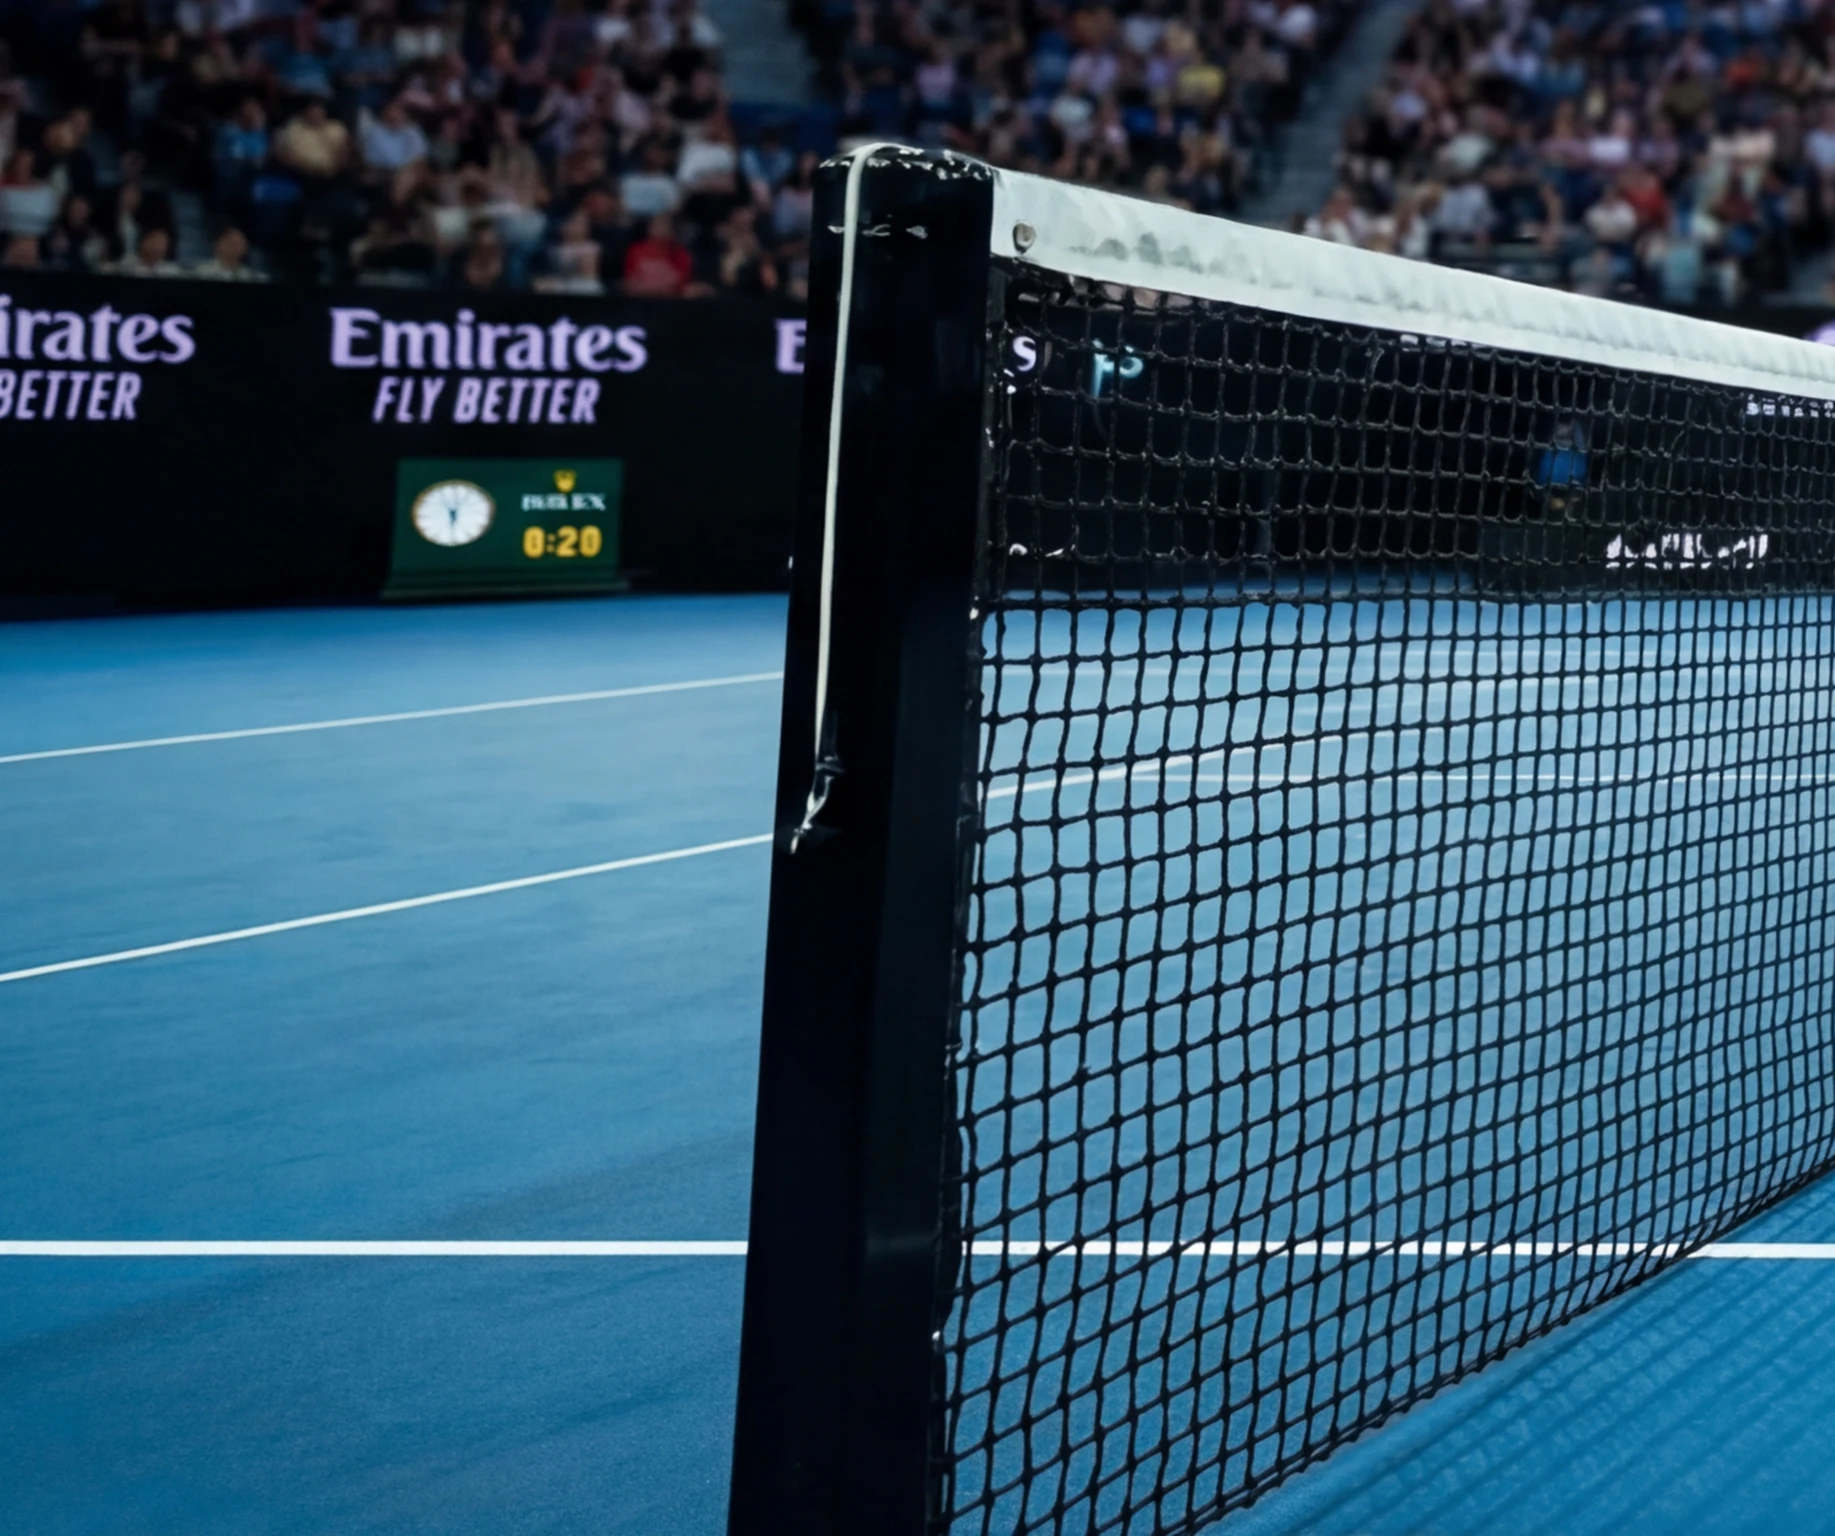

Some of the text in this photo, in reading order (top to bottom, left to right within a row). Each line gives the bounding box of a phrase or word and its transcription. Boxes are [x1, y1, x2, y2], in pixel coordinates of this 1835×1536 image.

[330, 308, 648, 372] Emirates
[372, 375, 601, 424] FLY BETTER
[523, 525, 602, 558] 0:20
